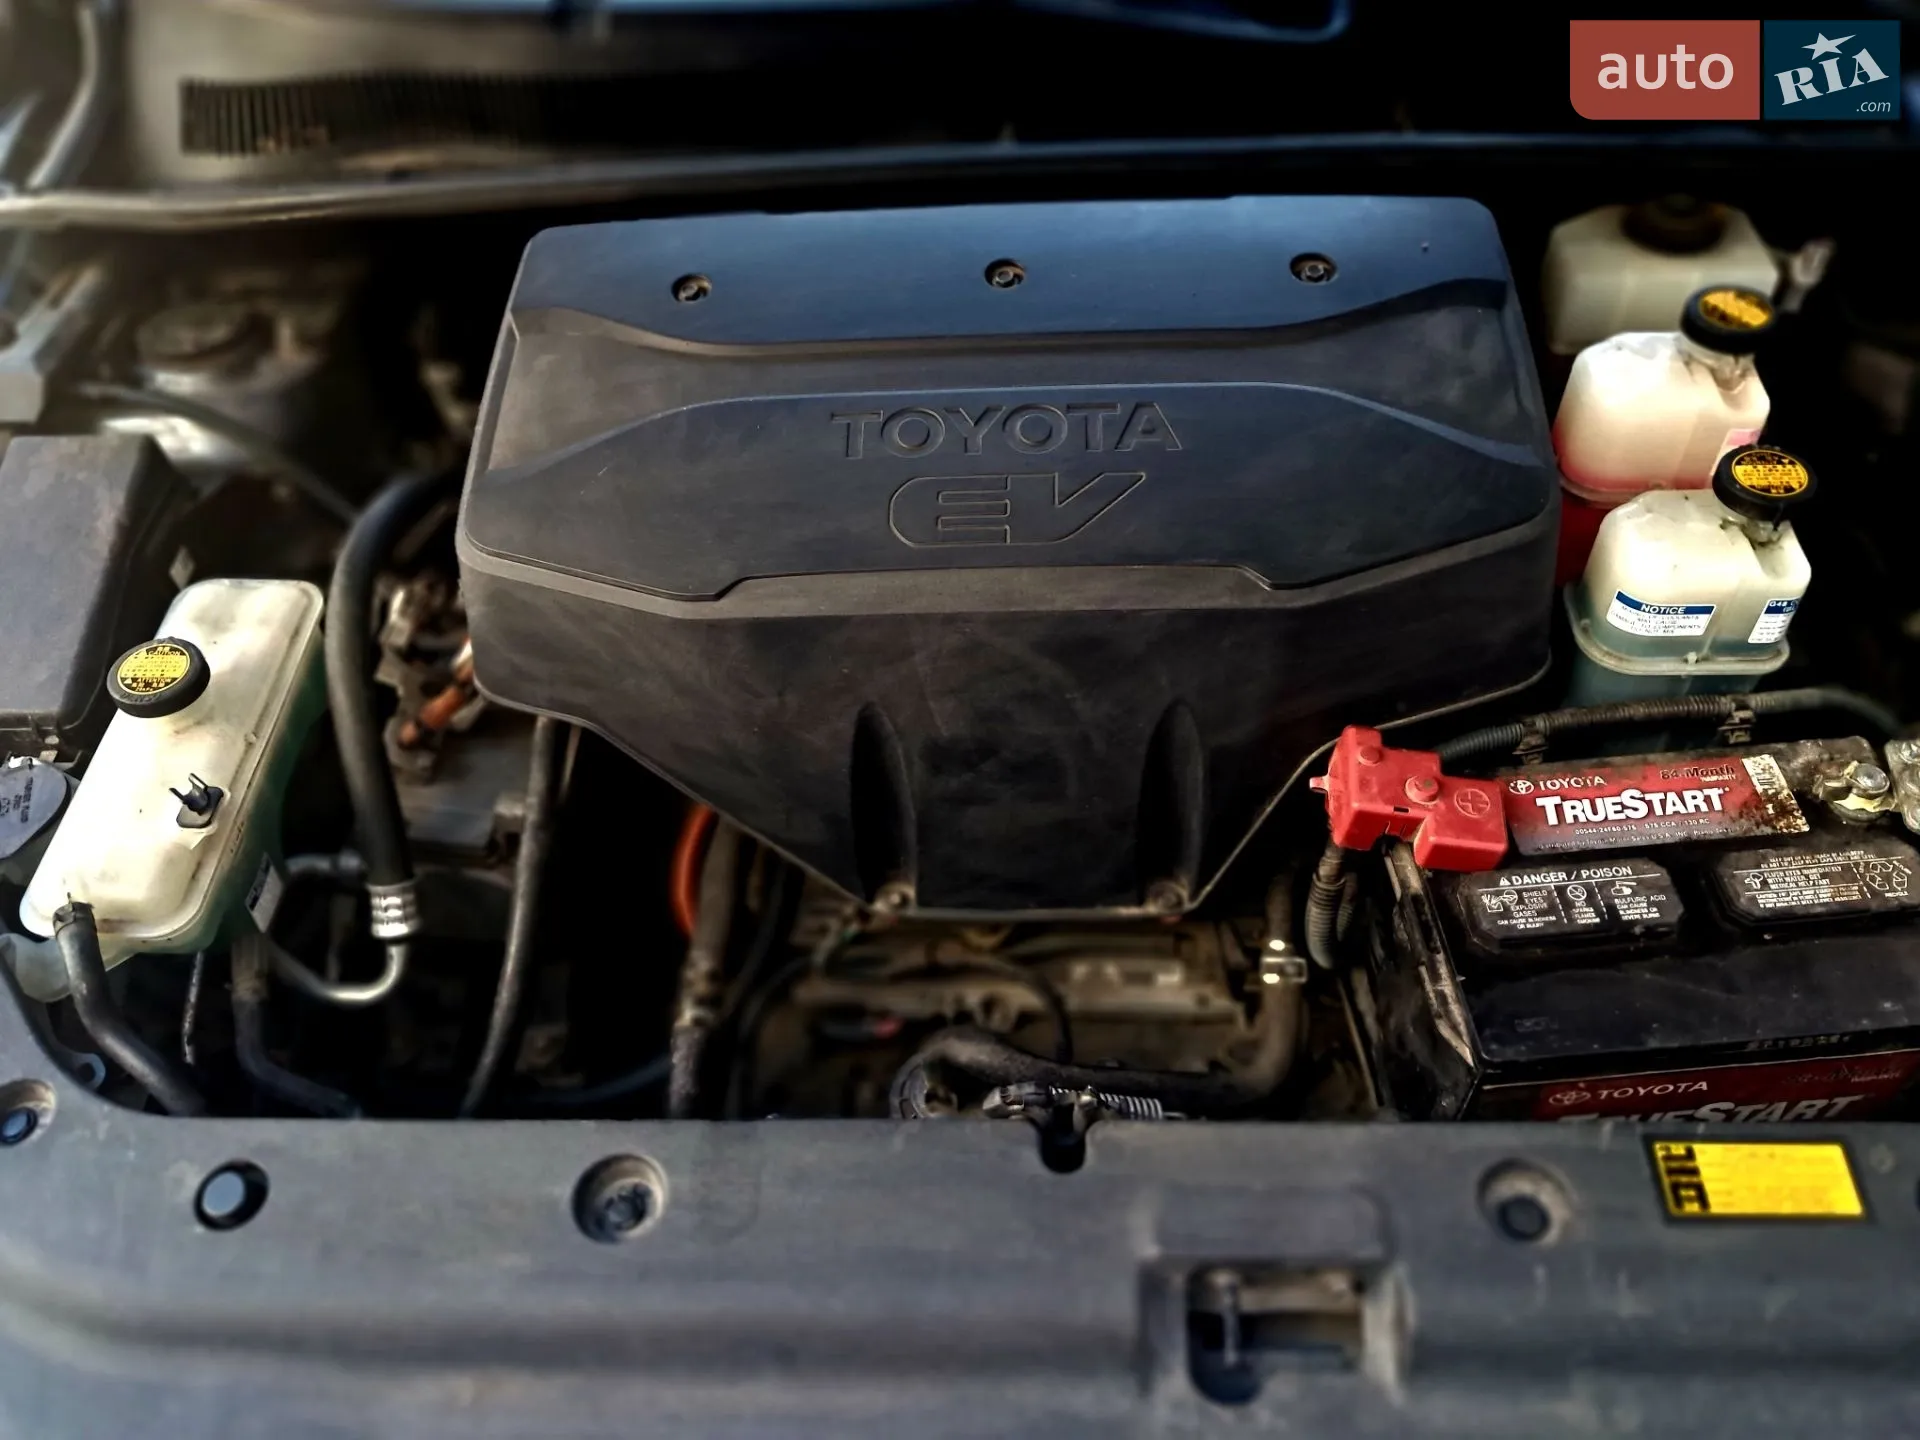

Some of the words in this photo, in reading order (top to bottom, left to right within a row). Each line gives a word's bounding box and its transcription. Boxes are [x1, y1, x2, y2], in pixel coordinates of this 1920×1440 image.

[831, 402, 1183, 459] TOYOTA
[889, 472, 1146, 548] EV
[1640, 604, 1687, 614] NOTICE
[1539, 775, 1607, 792] TOYOTA
[1511, 871, 1568, 885] DANGER
[1581, 866, 1632, 879] POISON
[1764, 870, 1785, 878] FLUSH
[1814, 878, 1831, 886] FAST
[1598, 1081, 1708, 1100] TOYOTA
